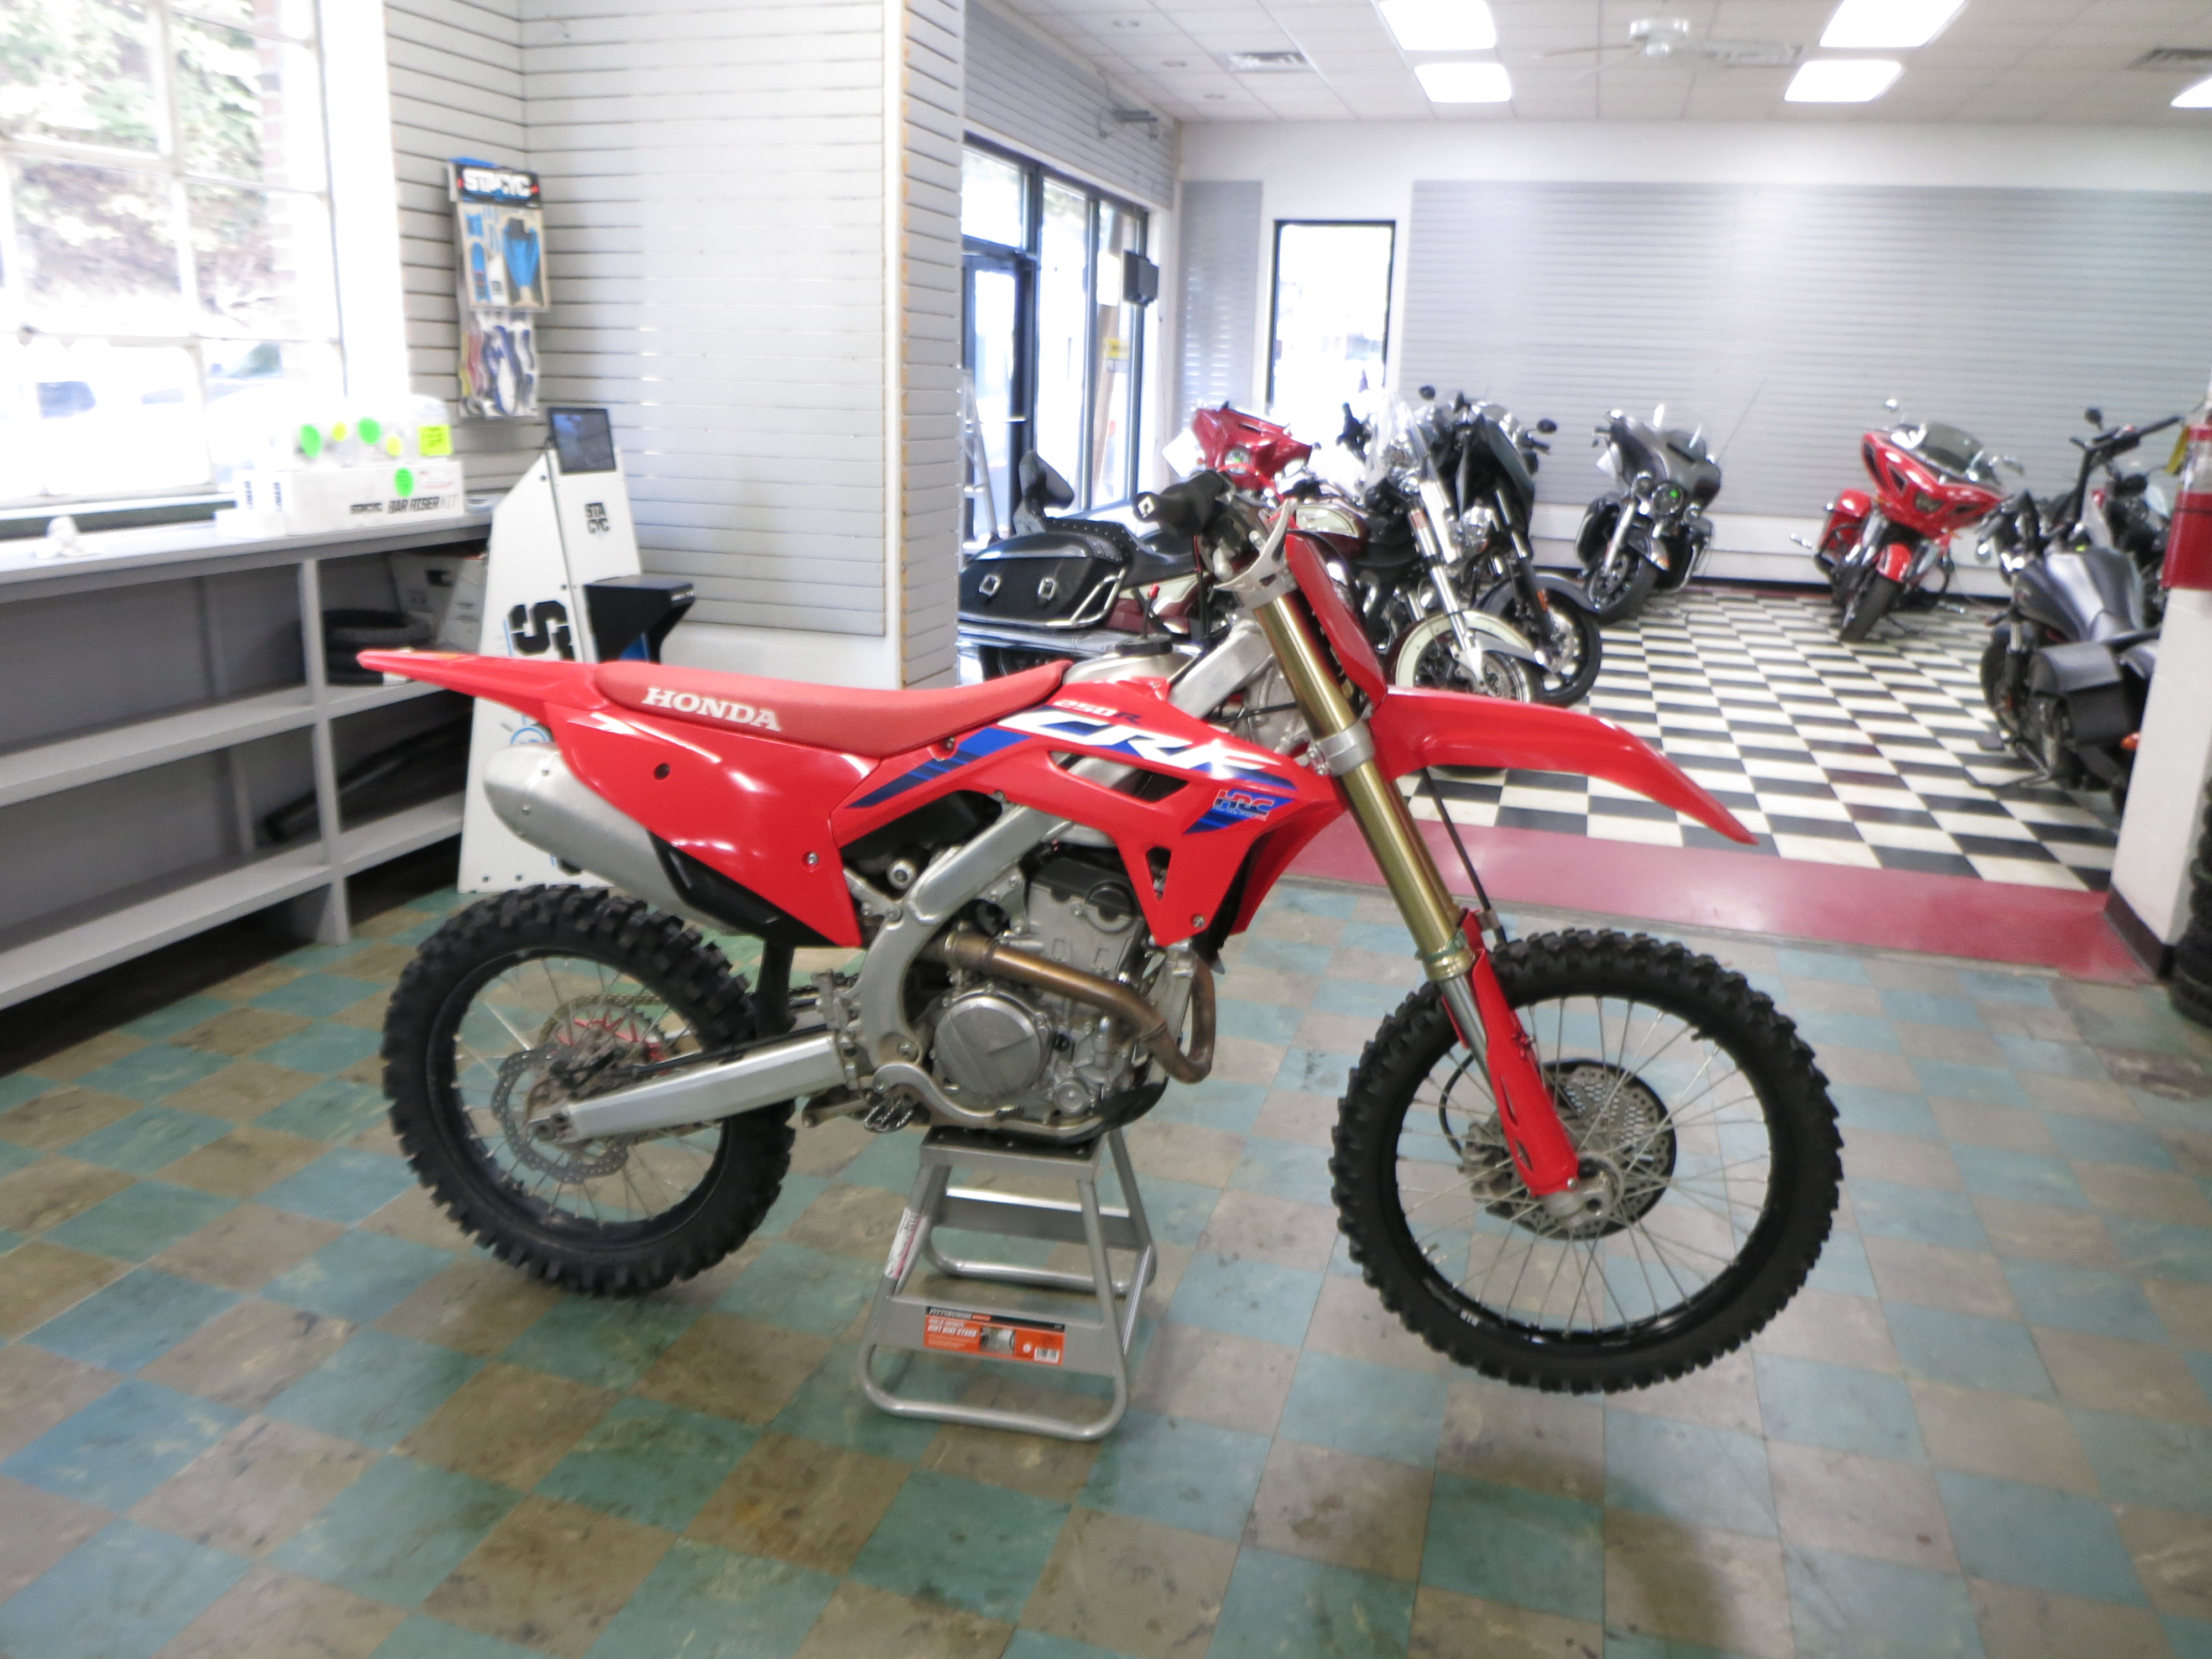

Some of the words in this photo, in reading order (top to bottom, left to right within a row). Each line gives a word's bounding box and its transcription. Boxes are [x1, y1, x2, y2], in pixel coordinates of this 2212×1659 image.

[388, 500, 409, 514] BAR
[410, 497, 440, 512] RISER
[641, 687, 782, 732] HONDA
[1052, 700, 1142, 726] 250R
[1212, 790, 1275, 817] HRC
[929, 1308, 972, 1320] PITTSBURGH
